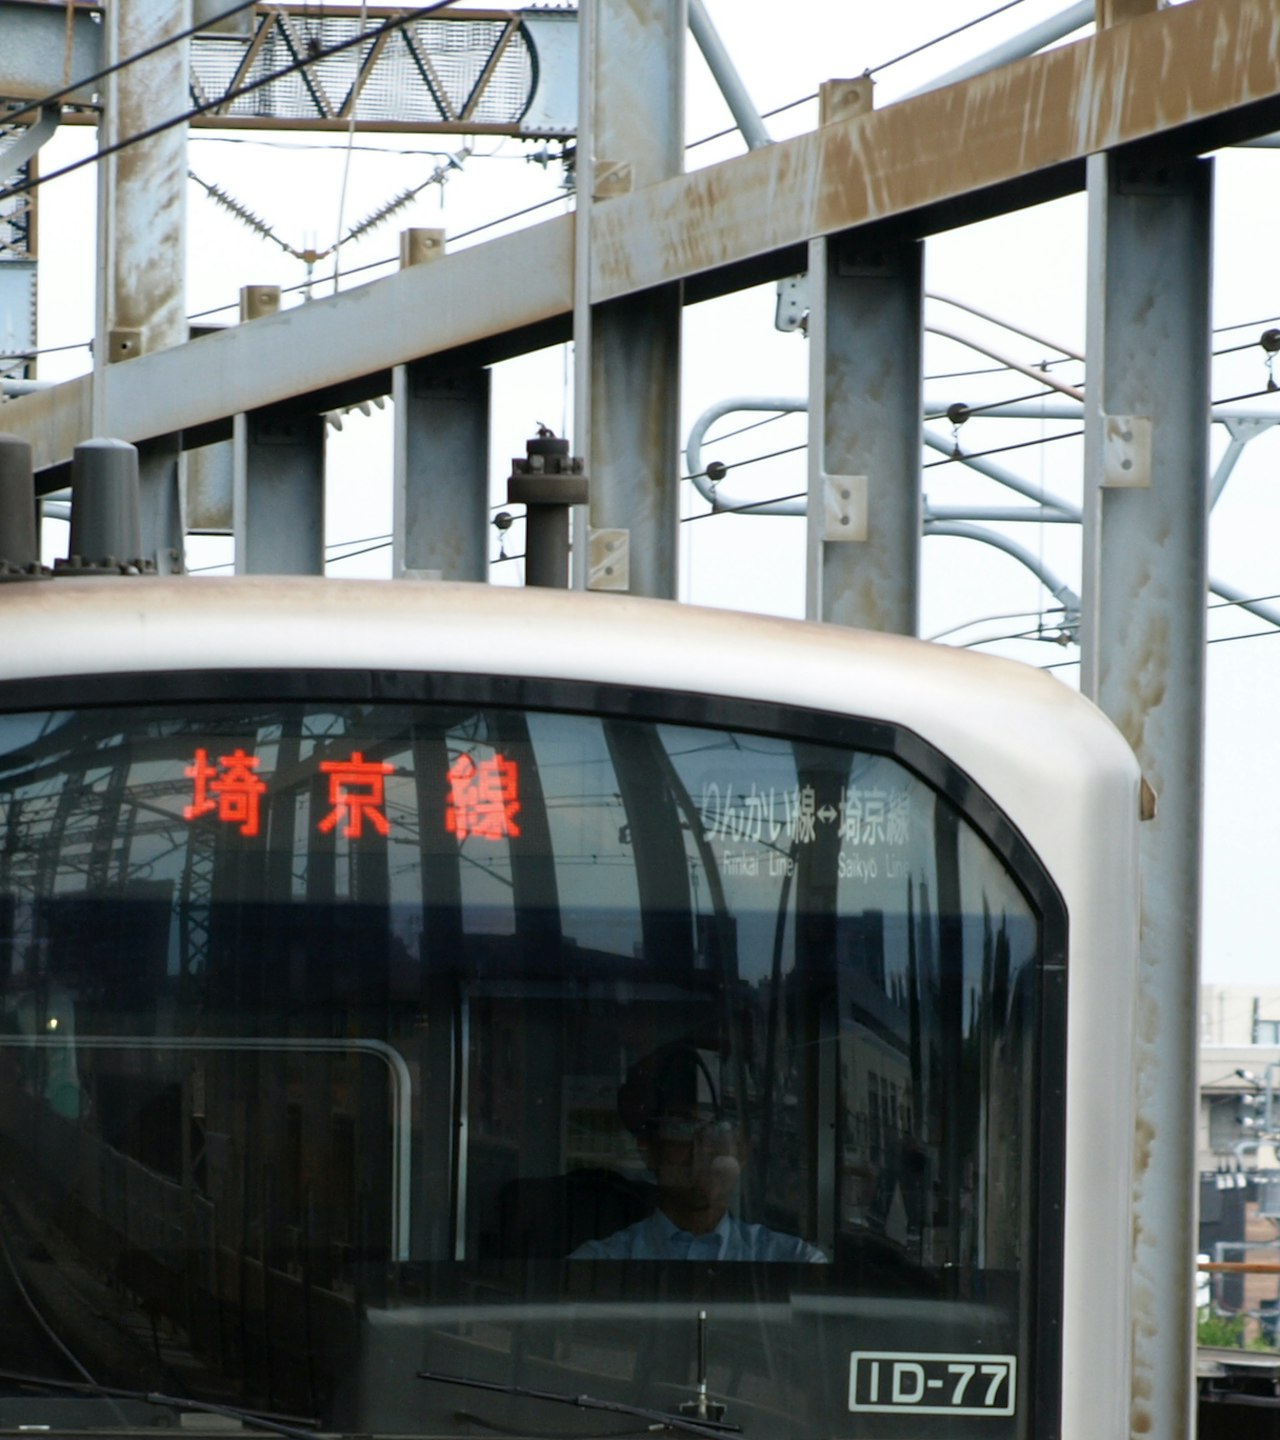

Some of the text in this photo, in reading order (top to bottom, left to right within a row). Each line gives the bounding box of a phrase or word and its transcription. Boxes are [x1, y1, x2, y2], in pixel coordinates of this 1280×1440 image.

[183, 747, 521, 841] 埼京線
[702, 782, 910, 846] りんかい線 埼京線
[723, 851, 910, 885] Rinkai Line Saikyo Line
[870, 1361, 1008, 1406] ID-77
